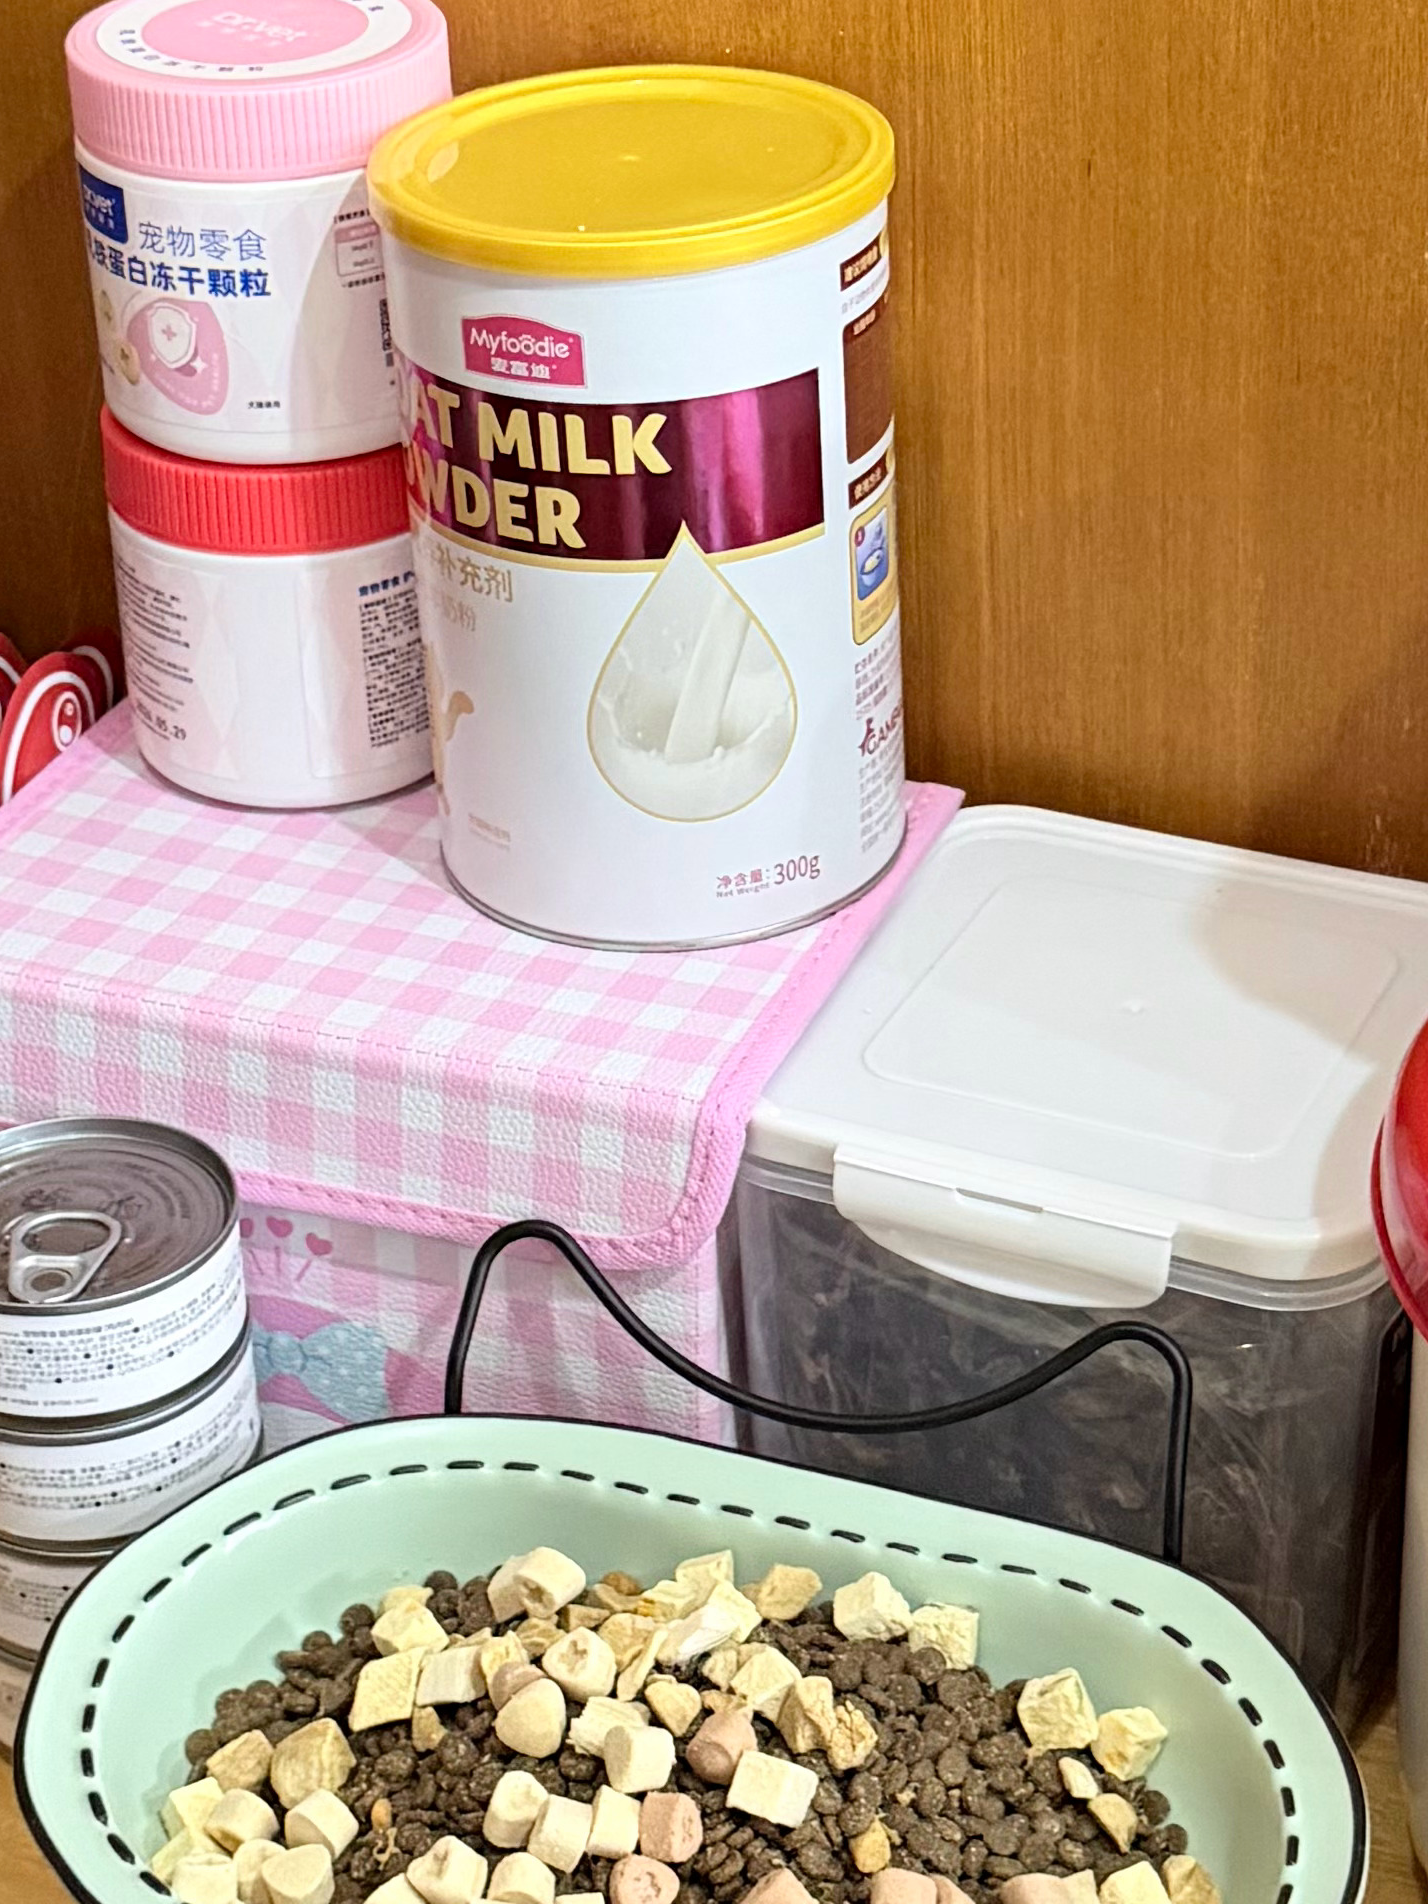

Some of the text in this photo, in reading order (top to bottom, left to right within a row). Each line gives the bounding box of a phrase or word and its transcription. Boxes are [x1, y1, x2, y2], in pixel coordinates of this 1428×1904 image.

[138, 221, 268, 262] 宠物零食
[470, 327, 570, 359] Myfoodie
[490, 357, 551, 380] 麦富迪
[478, 401, 672, 476] MILK
[774, 854, 821, 885] 300g
